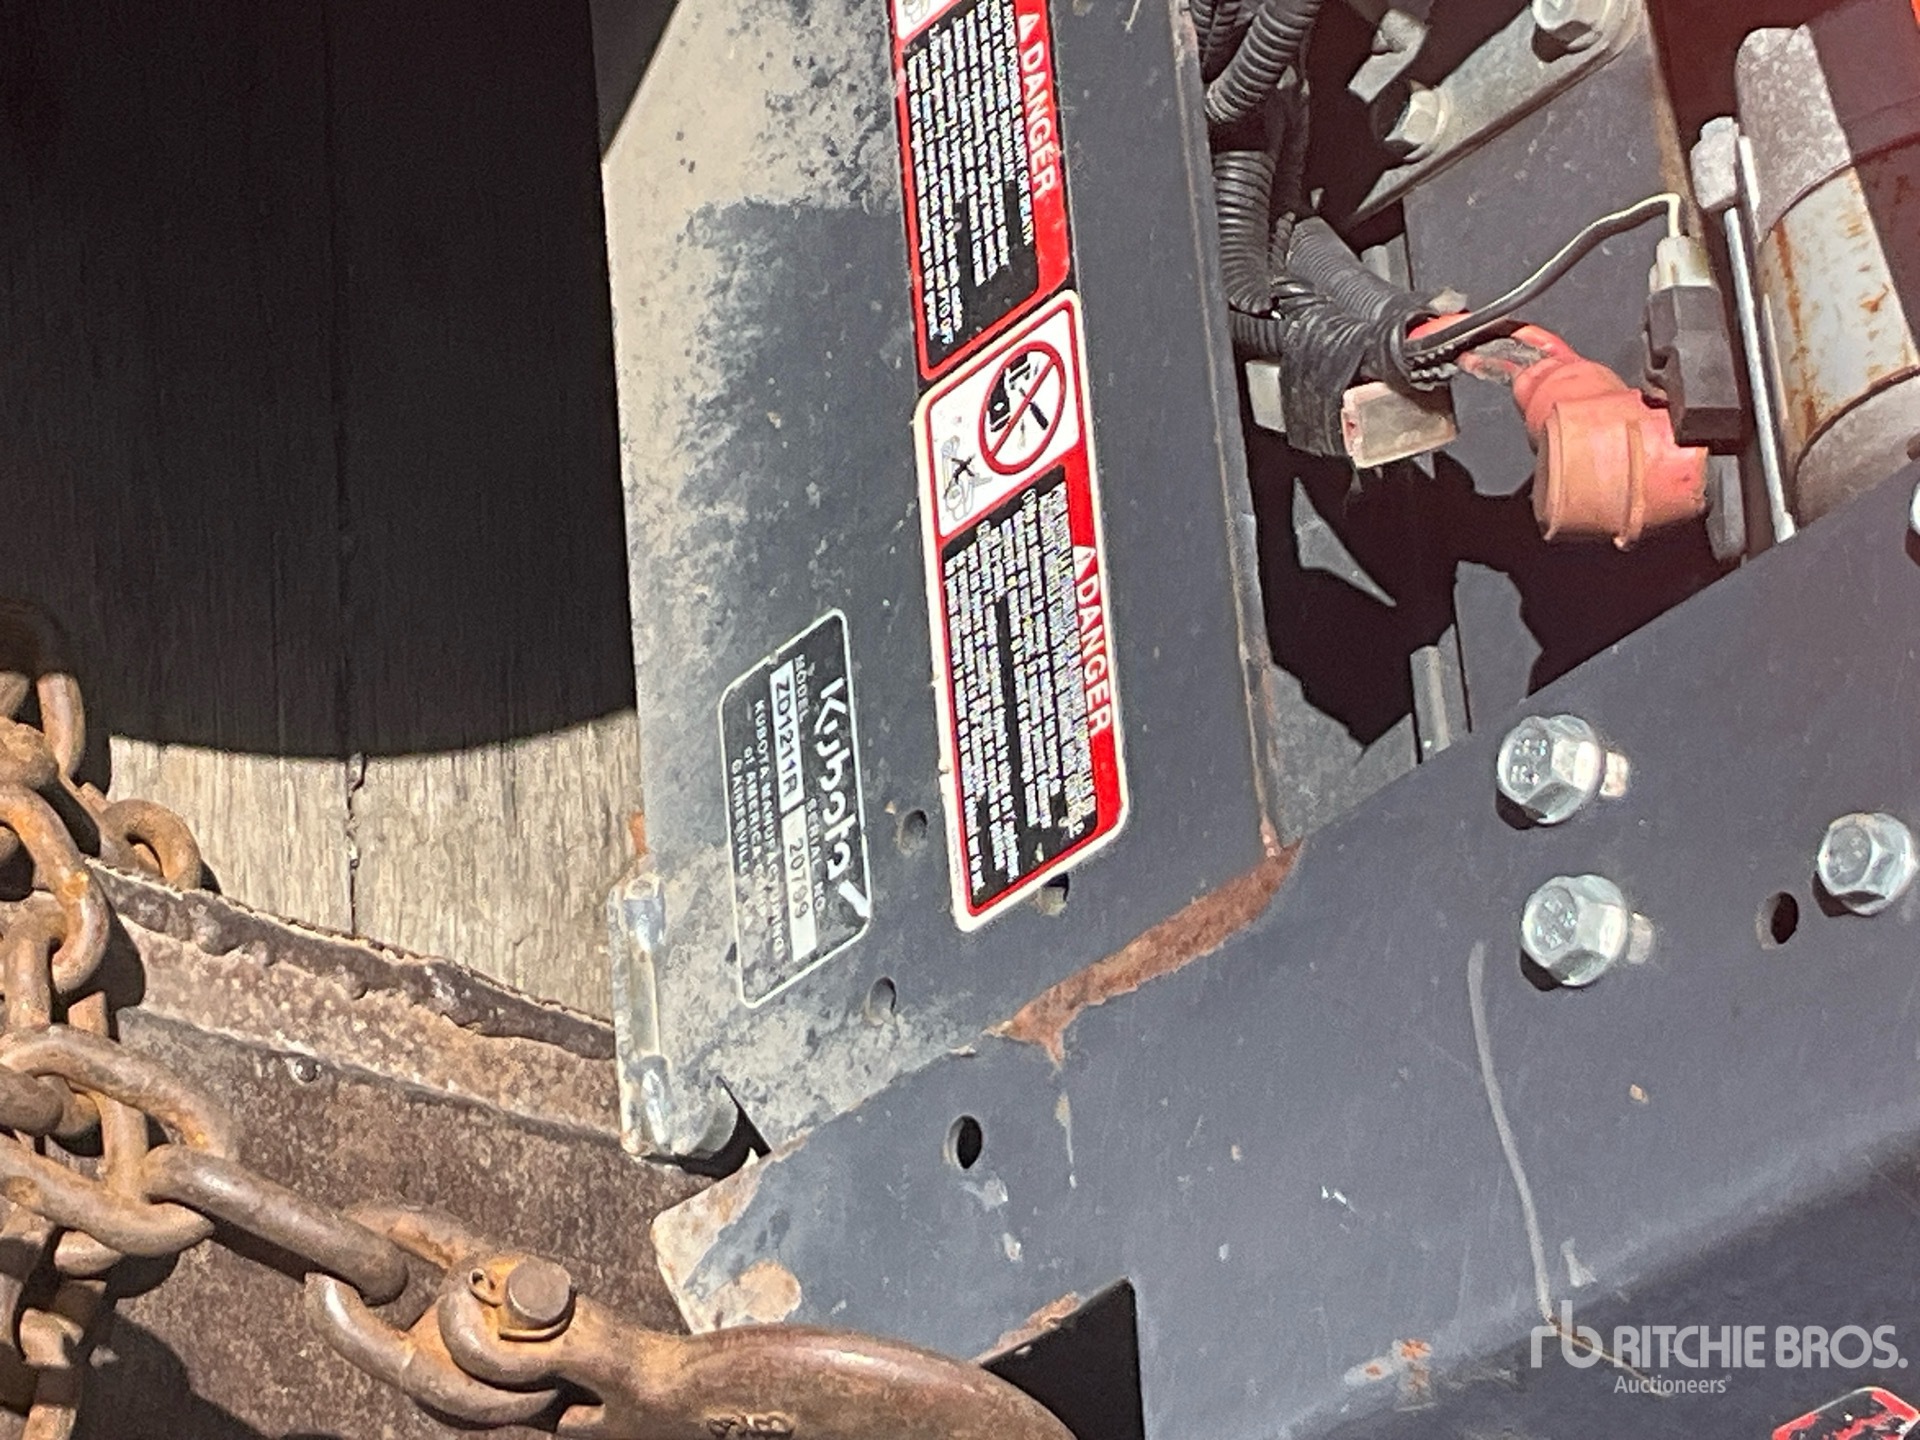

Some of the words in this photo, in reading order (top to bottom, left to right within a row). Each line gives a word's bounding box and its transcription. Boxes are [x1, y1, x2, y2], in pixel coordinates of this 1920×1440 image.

[1022, 42, 1056, 198] DANGER
[793, 651, 810, 724] MODEL
[1078, 575, 1111, 735] DANGER
[753, 697, 771, 781] KUBOTA
[774, 674, 799, 799] ZD1211R
[810, 674, 860, 884] Kubota
[745, 768, 763, 861] AMERICA
